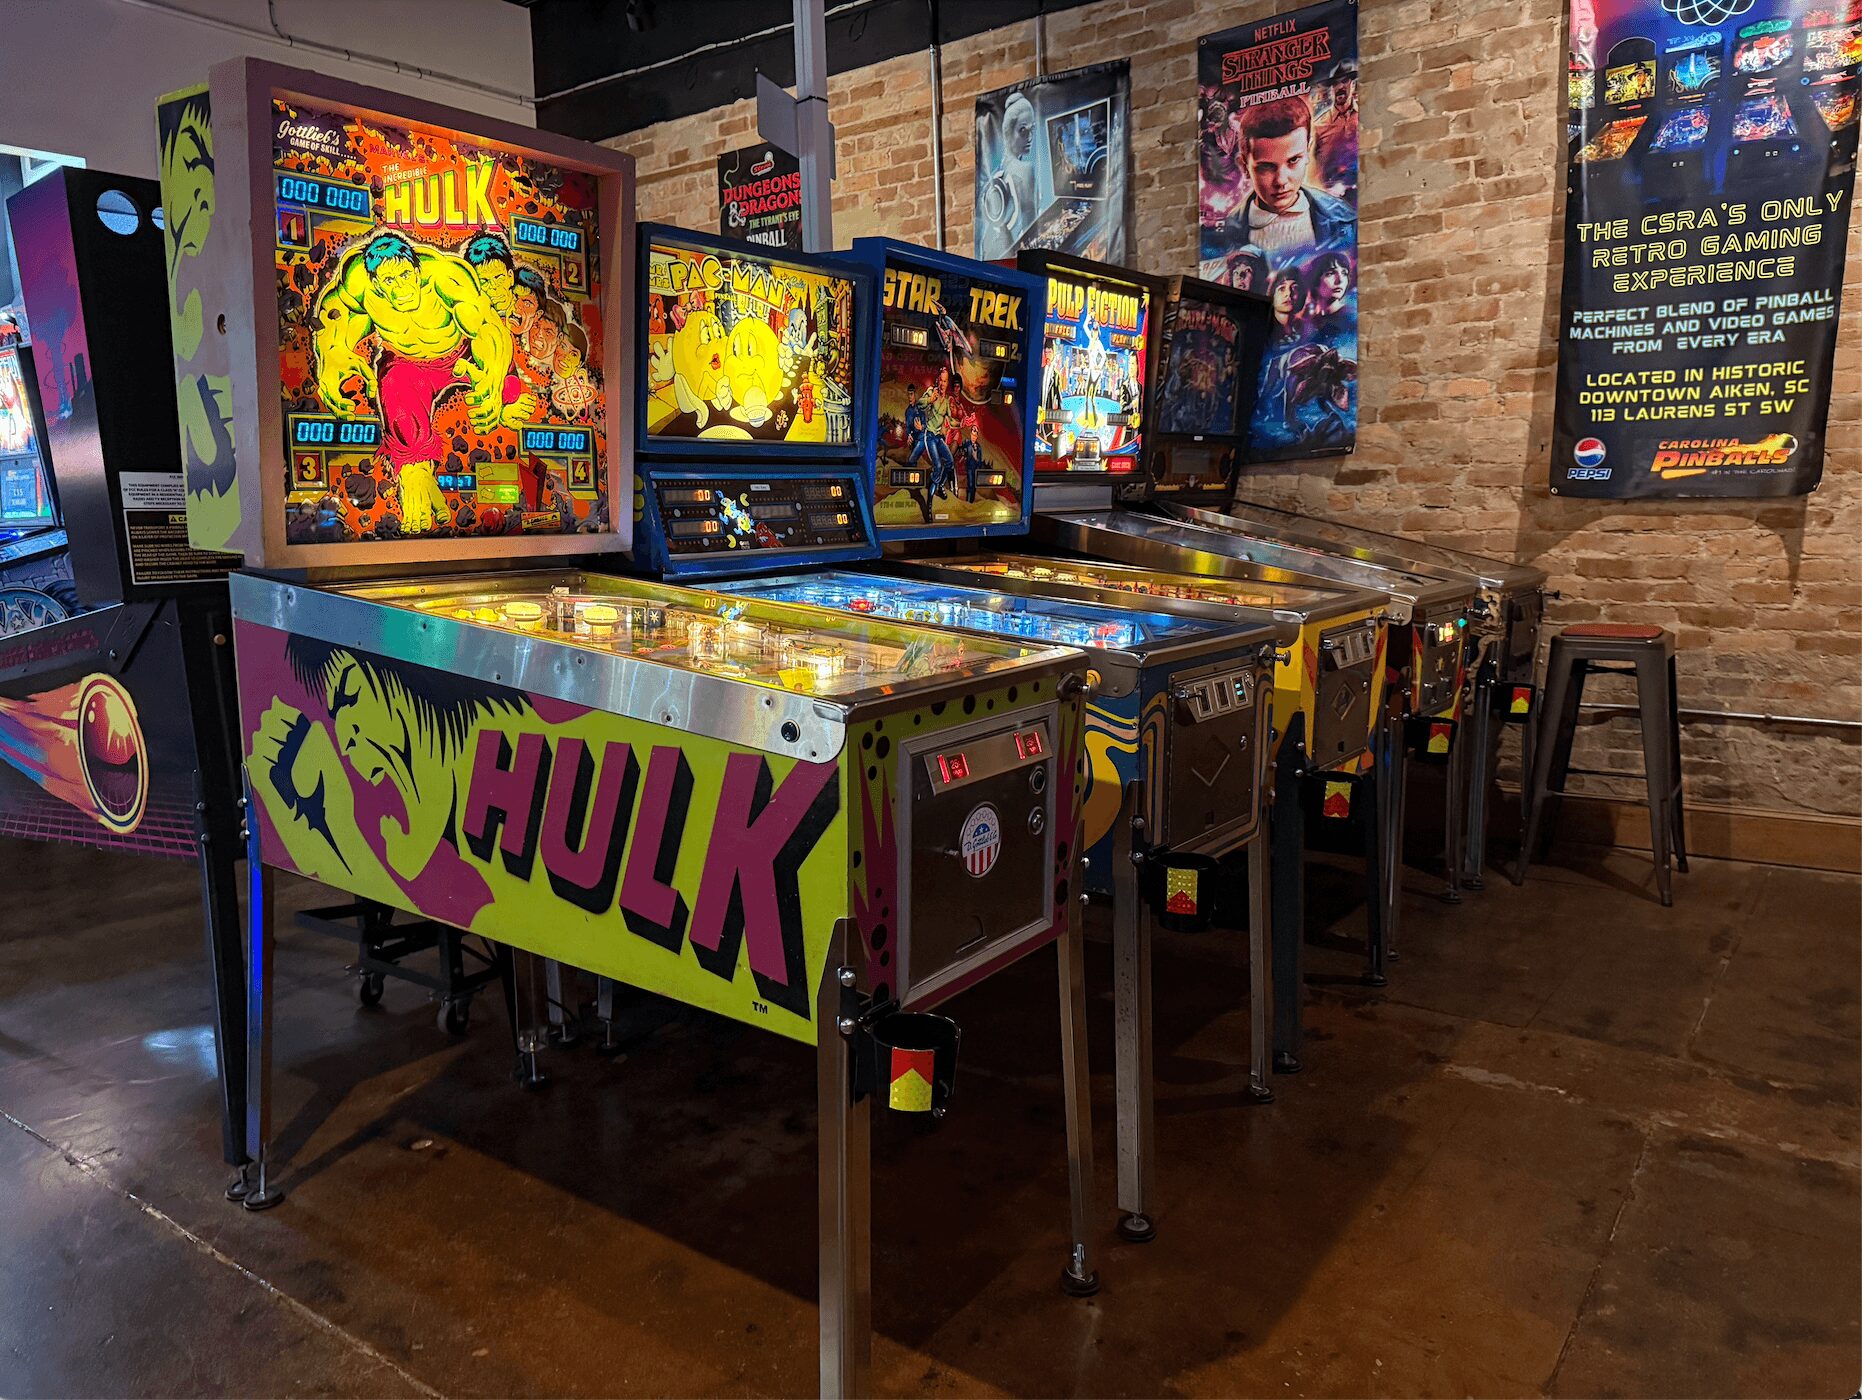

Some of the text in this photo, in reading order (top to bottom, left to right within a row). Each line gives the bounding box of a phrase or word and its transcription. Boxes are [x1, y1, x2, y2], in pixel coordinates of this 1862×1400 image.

[1254, 18, 1297, 42] NETFLIX
[1222, 31, 1331, 80] STRANGER
[1240, 58, 1313, 92] THINGS
[1239, 81, 1311, 109] PINBALL
[277, 120, 340, 146] Gottlieb's
[289, 137, 310, 149] GAME
[310, 140, 320, 150] OF
[382, 163, 400, 173] THE
[383, 166, 427, 184] INCREDIBLE
[282, 178, 361, 210] 000 000
[385, 160, 502, 231] HULK
[722, 171, 801, 204] DUNGEONS
[728, 201, 747, 228] &
[749, 210, 800, 229] THE TYRANT'S EYE
[1577, 189, 1844, 243] THE CSRA'S ONLY
[286, 216, 297, 240] 1
[1592, 224, 1822, 268] RETRO GAMING
[568, 262, 579, 284] 2
[668, 254, 786, 311] PAC-MAN
[1613, 256, 1795, 293] EXPERIENCE
[882, 267, 1022, 330] STAR TREK
[1047, 278, 1085, 322] PULP
[1087, 286, 1139, 332] FICTION
[1573, 288, 1834, 323] PERFECT BLEND OF PINBALL
[1569, 304, 1835, 339] MACHINES AND VIDEO GAMES
[1612, 329, 1786, 354] FROM EVERY ERA
[1586, 360, 1805, 387] LOCATED IN HISTORIC
[1579, 379, 1810, 405] DOWNTOWN AIKEN, SC
[1591, 399, 1794, 422] 113 LAURENS ST SW
[297, 421, 375, 443] 000 000
[1658, 437, 1740, 450] CAROLINA
[301, 456, 317, 480] 3
[574, 461, 587, 480] 4
[1651, 448, 1790, 472] PINBALLS
[1567, 468, 1612, 480] PEPSI
[462, 729, 841, 1021] HULK
[752, 1001, 768, 1014] TM
